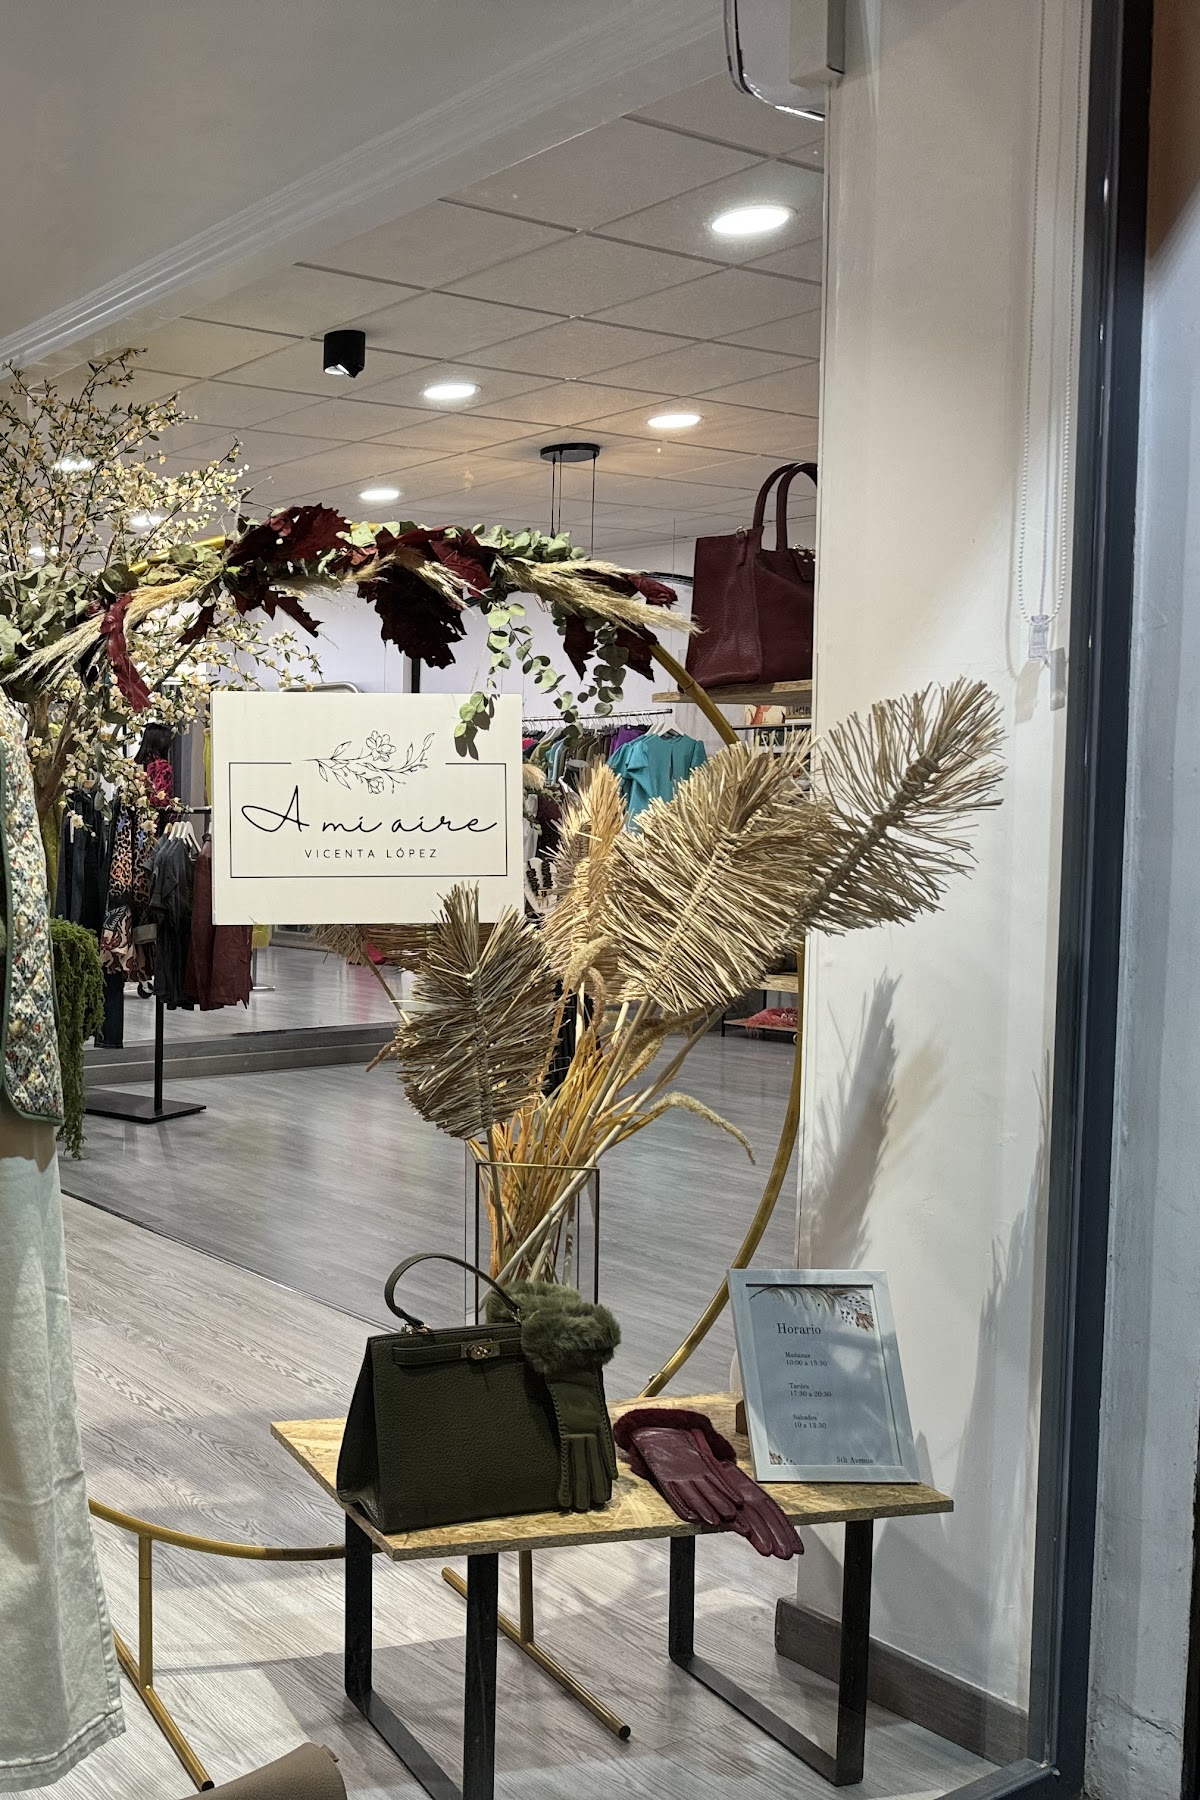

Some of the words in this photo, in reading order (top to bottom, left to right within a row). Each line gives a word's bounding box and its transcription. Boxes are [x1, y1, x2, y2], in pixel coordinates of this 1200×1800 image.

[241, 784, 310, 833] A
[322, 815, 383, 833] mi
[391, 815, 497, 833] aire
[304, 848, 376, 859] VICENTA
[386, 847, 437, 858] LÓPEZ
[776, 1322, 822, 1335] Horario
[785, 1351, 811, 1359] Mañanas
[836, 1456, 847, 1464] 5th
[850, 1456, 874, 1464] Avenue
